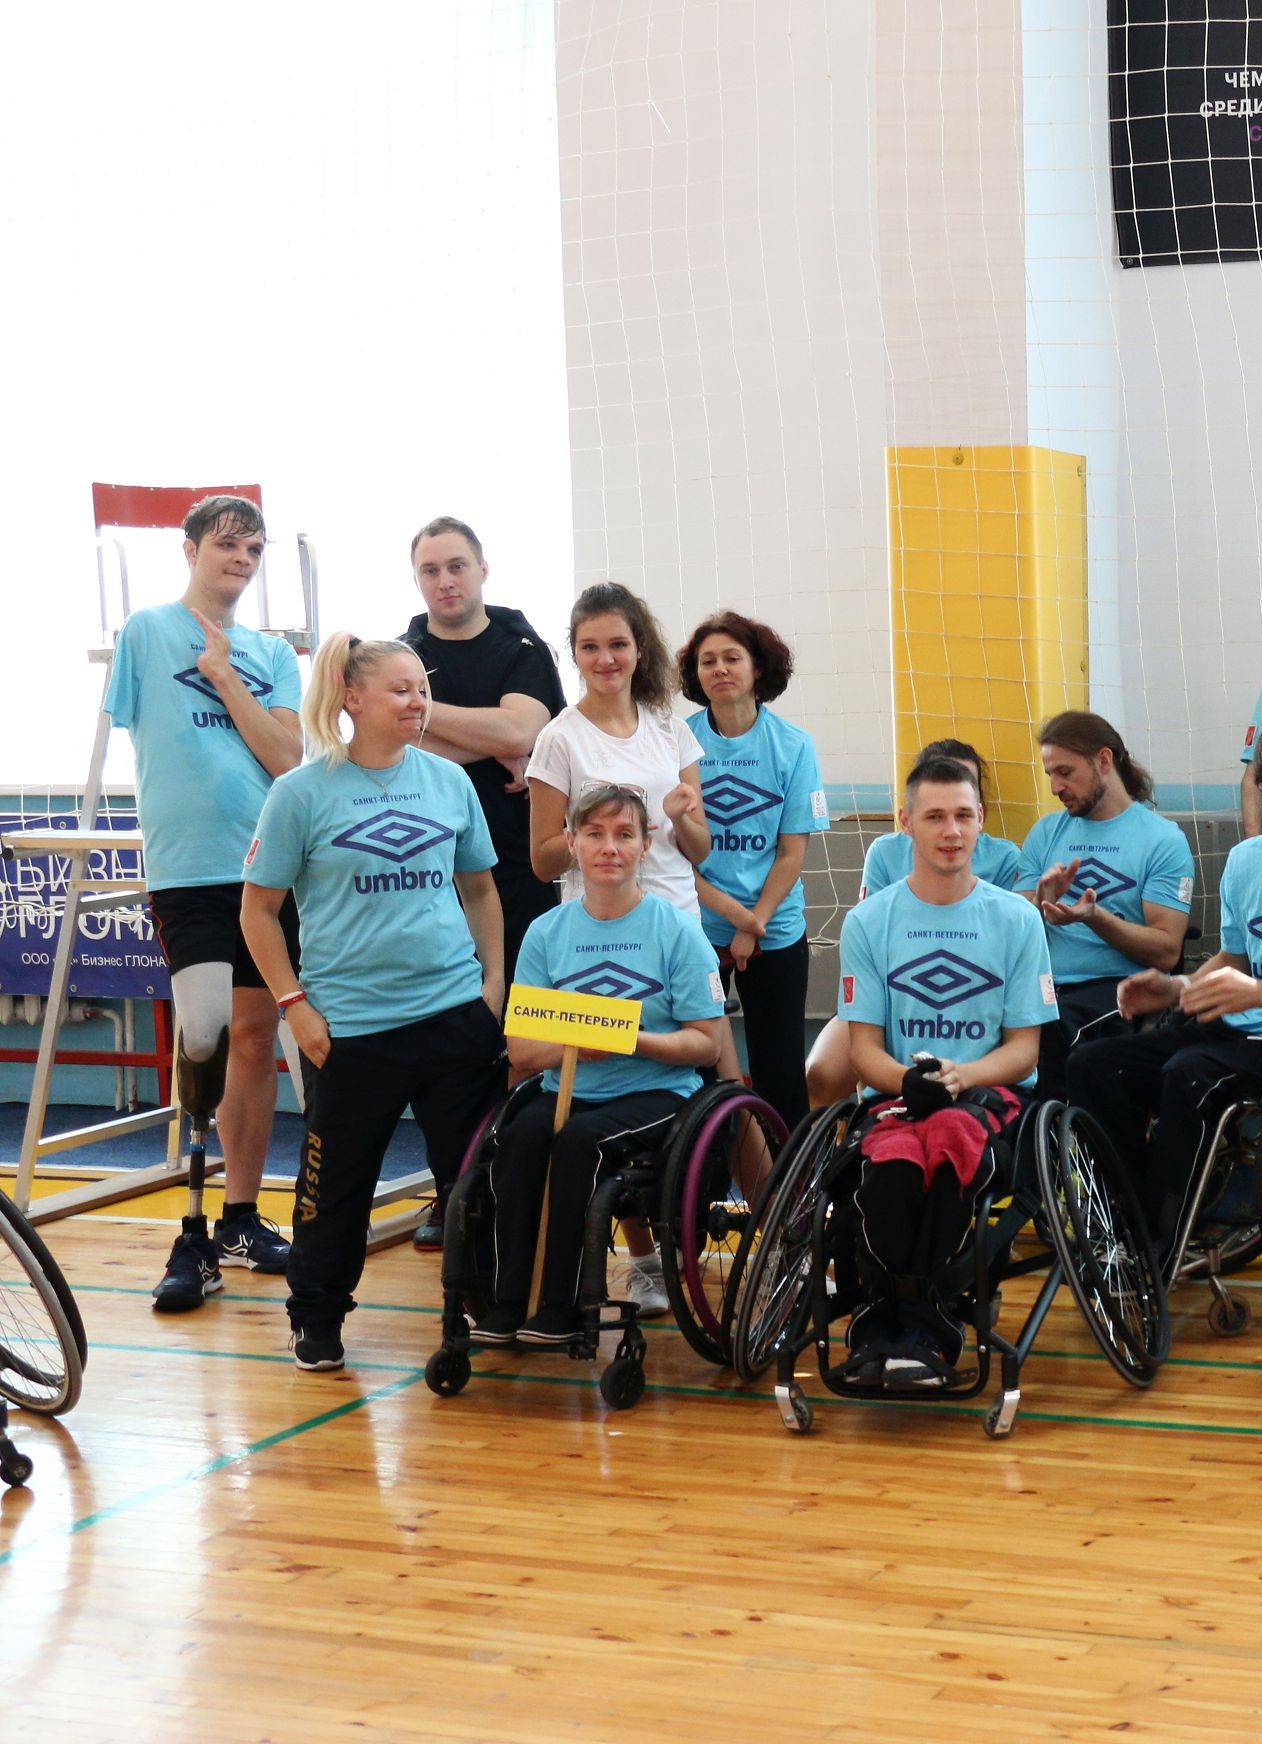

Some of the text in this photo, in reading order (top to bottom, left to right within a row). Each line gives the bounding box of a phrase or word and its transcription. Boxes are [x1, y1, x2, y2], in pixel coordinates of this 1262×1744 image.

[352, 793, 422, 806] САНКТ-ПЕТЕРБУРГ
[354, 866, 444, 895] umbro
[907, 930, 979, 941] САНКТ-ПЕТЕРБУРГ
[575, 943, 642, 953] САНКТ-ПЕТЕРБУРГ
[21, 952, 50, 965] ООО
[81, 954, 123, 966] Бизнес
[513, 1005, 634, 1030] САНКТ-ПЕТЕРБУРГ
[298, 1131, 322, 1222] RUSSIA
